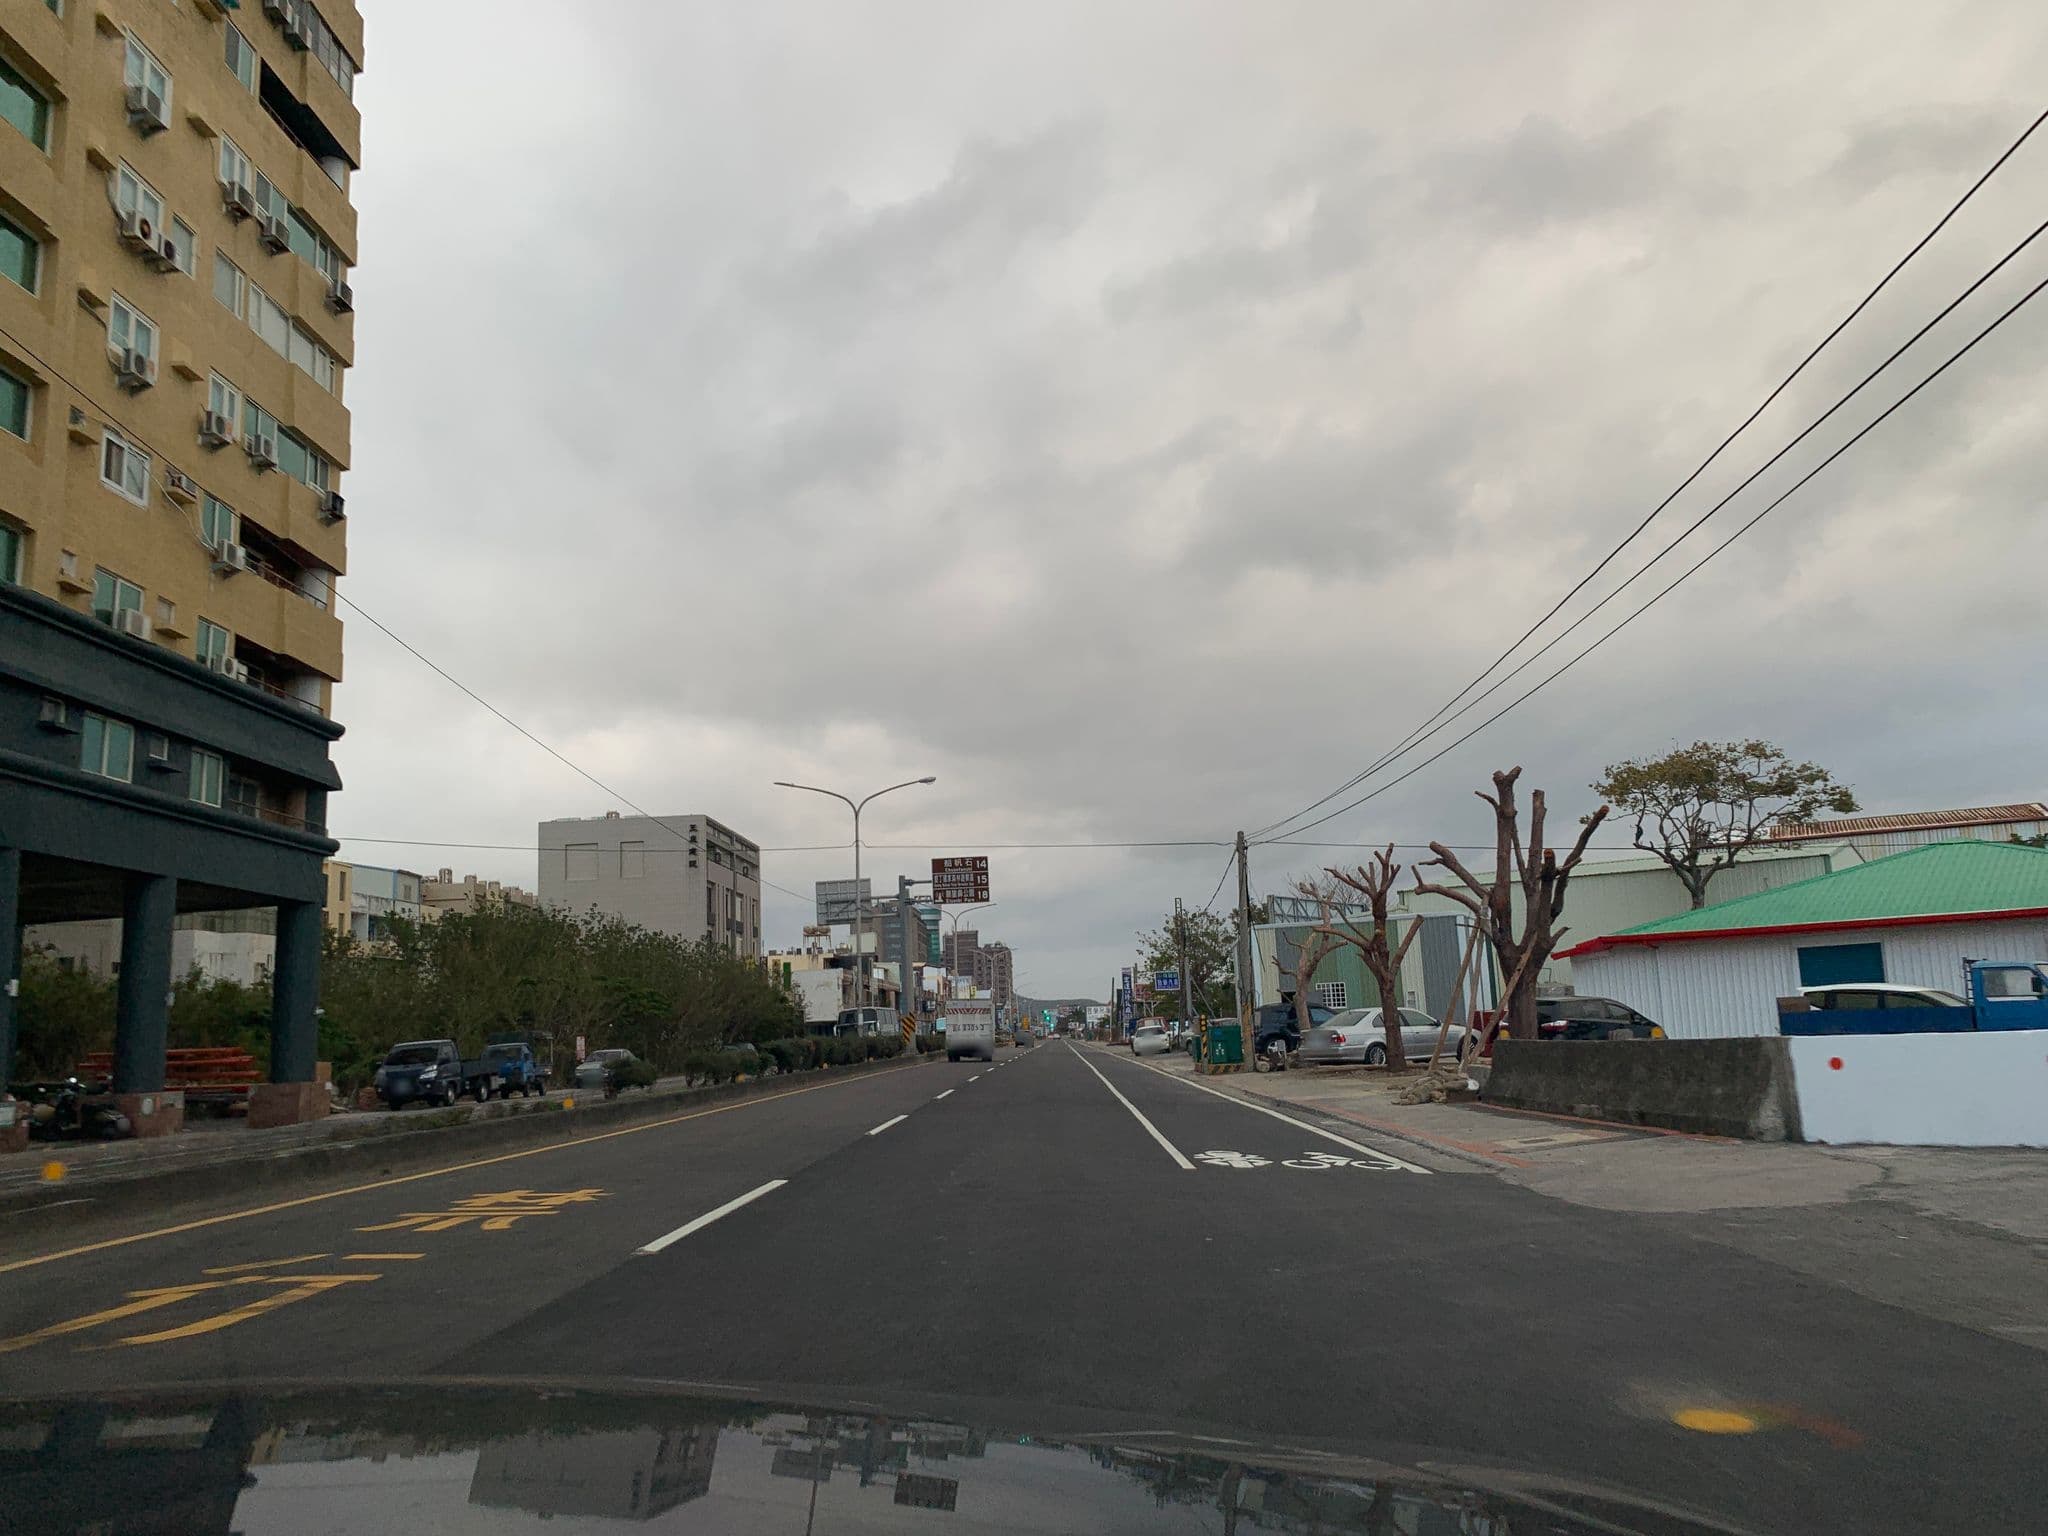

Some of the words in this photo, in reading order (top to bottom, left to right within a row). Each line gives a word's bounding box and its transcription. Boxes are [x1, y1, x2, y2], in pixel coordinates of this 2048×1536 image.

[976, 860, 987, 869] 14
[977, 875, 988, 884] 15
[978, 890, 988, 899] 18
